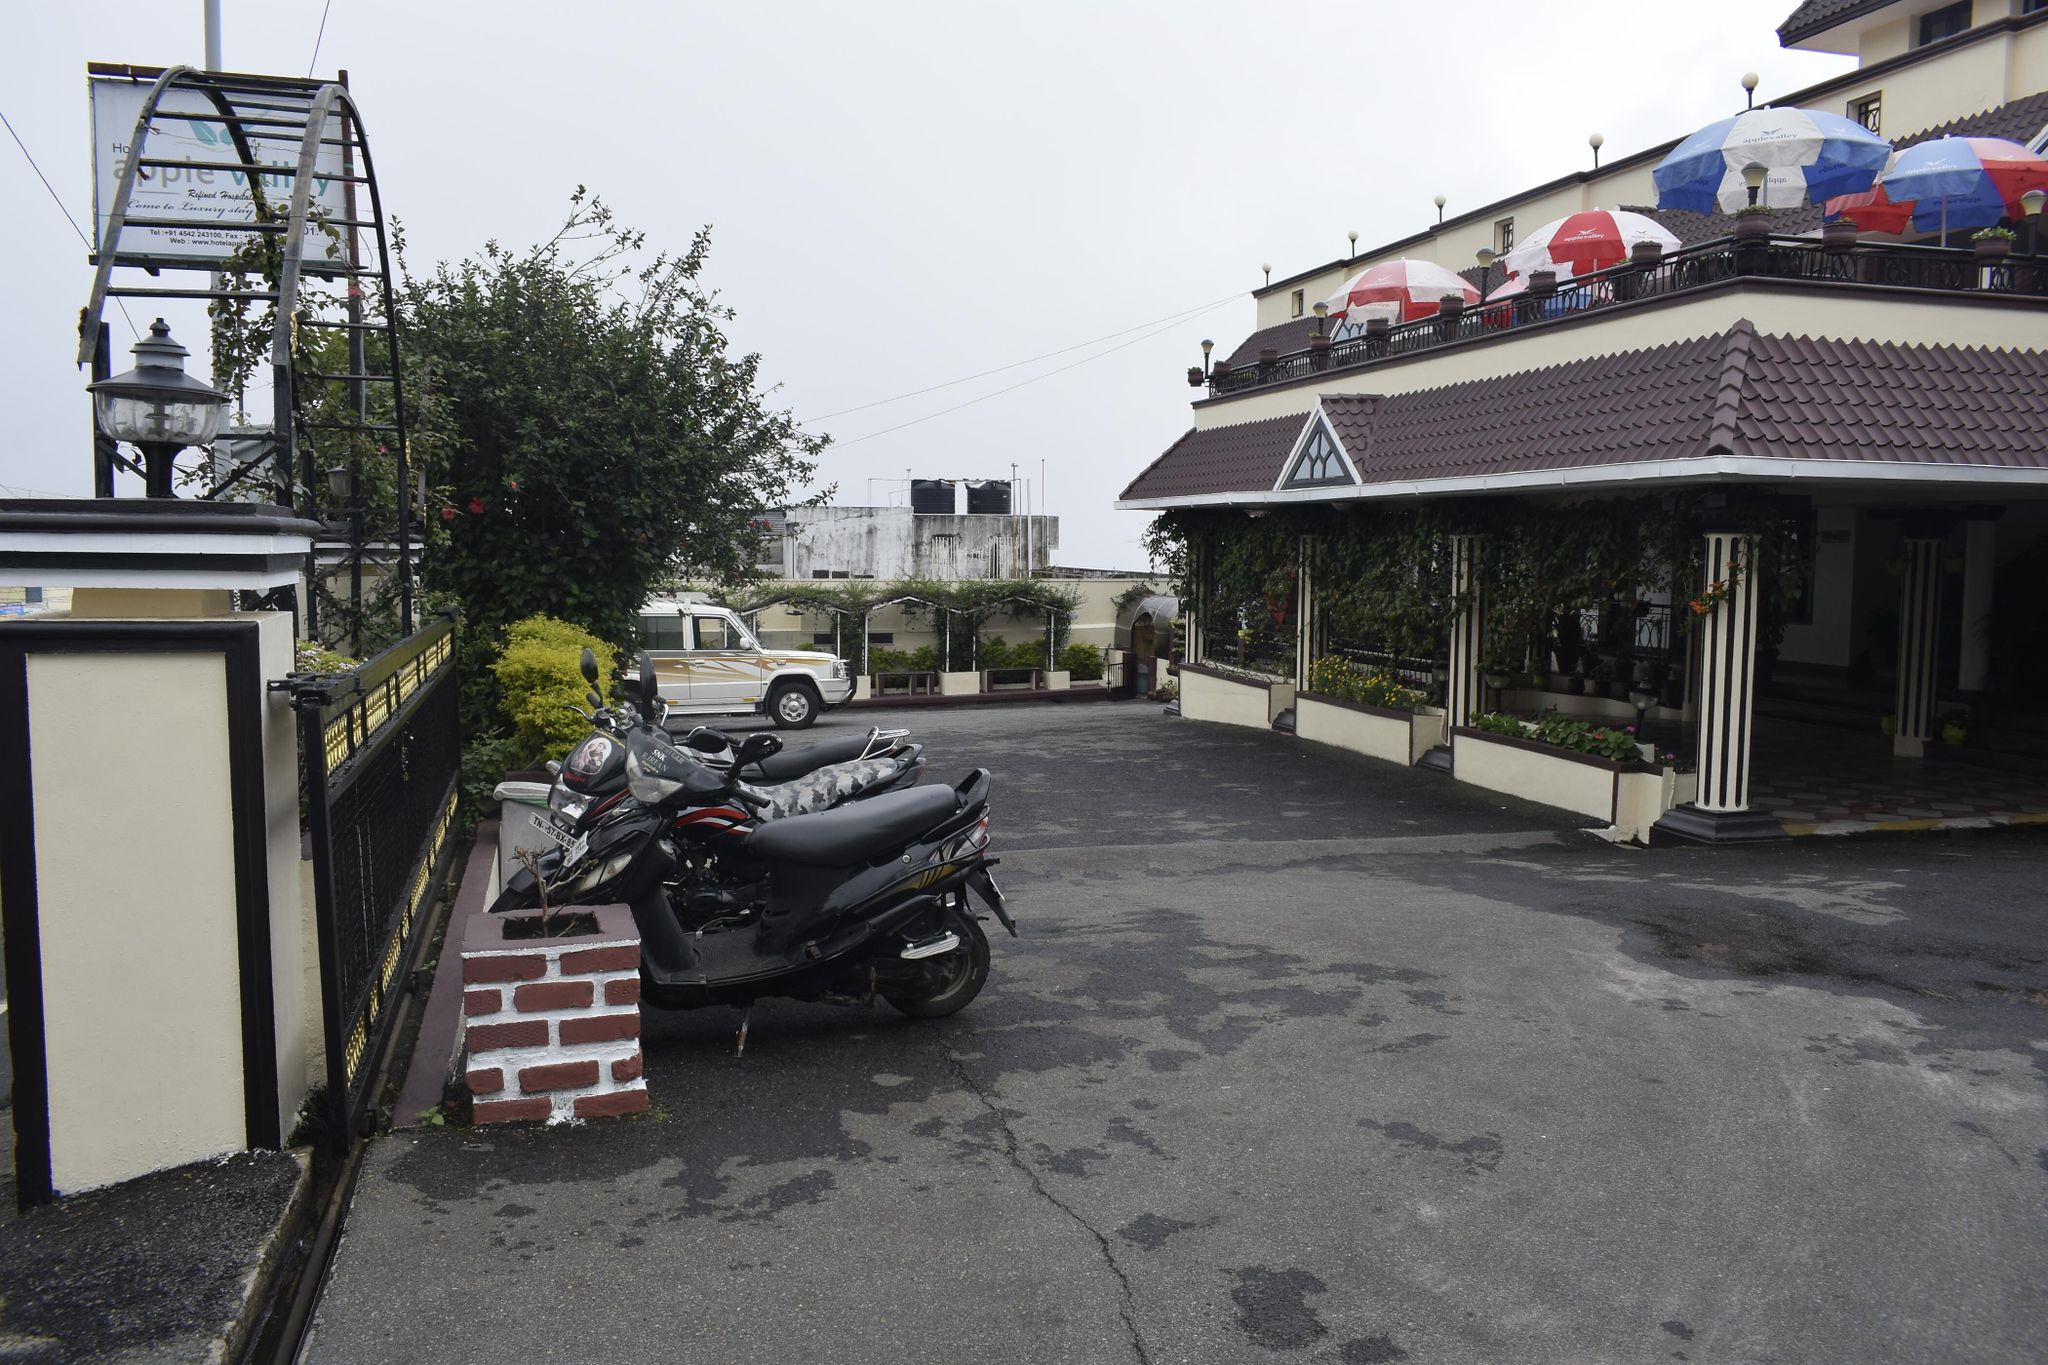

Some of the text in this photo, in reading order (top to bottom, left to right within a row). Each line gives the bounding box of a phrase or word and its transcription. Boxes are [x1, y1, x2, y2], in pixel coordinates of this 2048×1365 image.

[112, 142, 146, 155] Hol
[187, 189, 217, 200] Refined
[127, 198, 160, 210] Come
[162, 201, 175, 210] to
[178, 201, 226, 219] Luxury
[170, 237, 186, 245] Web
[178, 230, 195, 238] 4542
[225, 232, 239, 240] Fax
[651, 749, 668, 762] SNK
